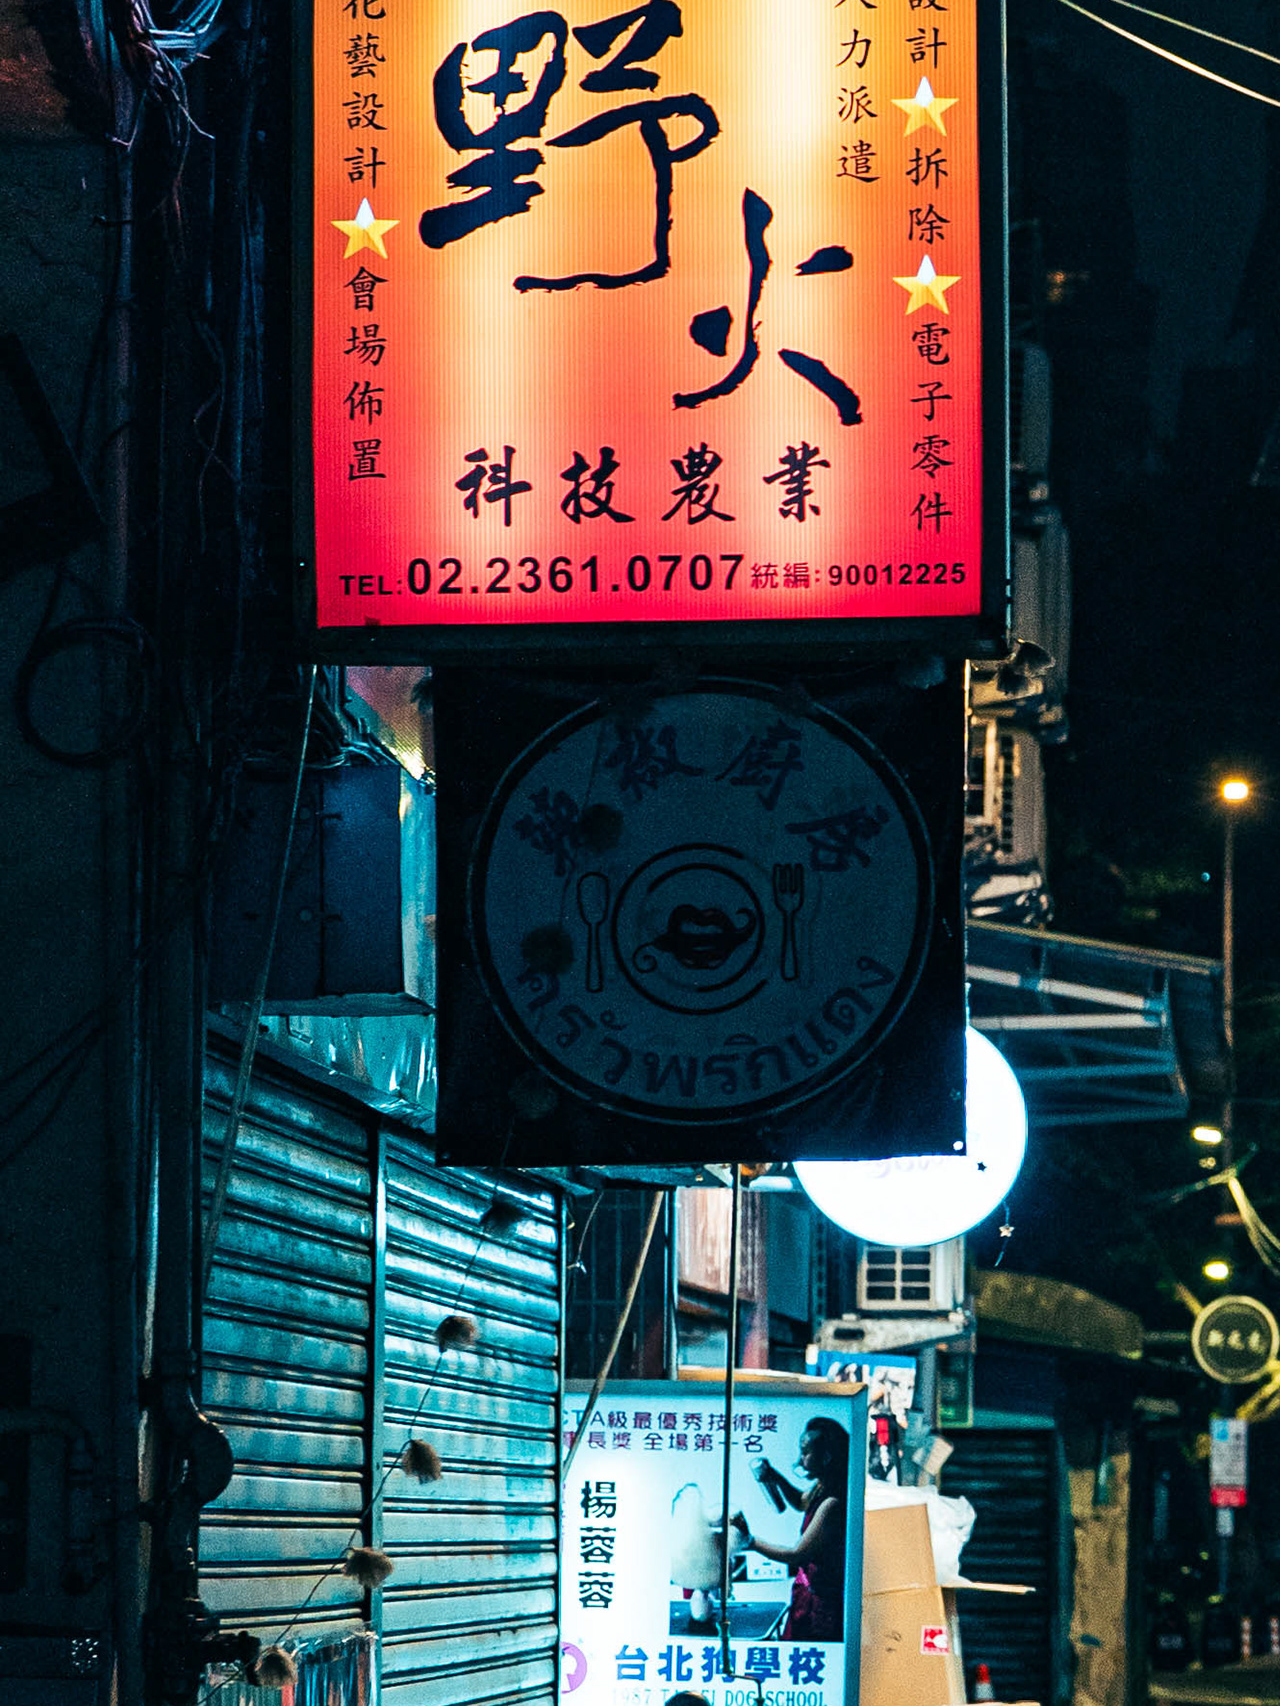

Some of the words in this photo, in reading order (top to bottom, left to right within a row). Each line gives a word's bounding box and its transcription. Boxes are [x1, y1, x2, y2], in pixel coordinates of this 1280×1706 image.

[906, 146, 951, 245] 拆除
[342, 265, 389, 482] 會場佈置
[909, 320, 956, 535] 電子零件
[455, 441, 832, 528] 科技農業
[615, 1644, 826, 1686] 台北狗學校
